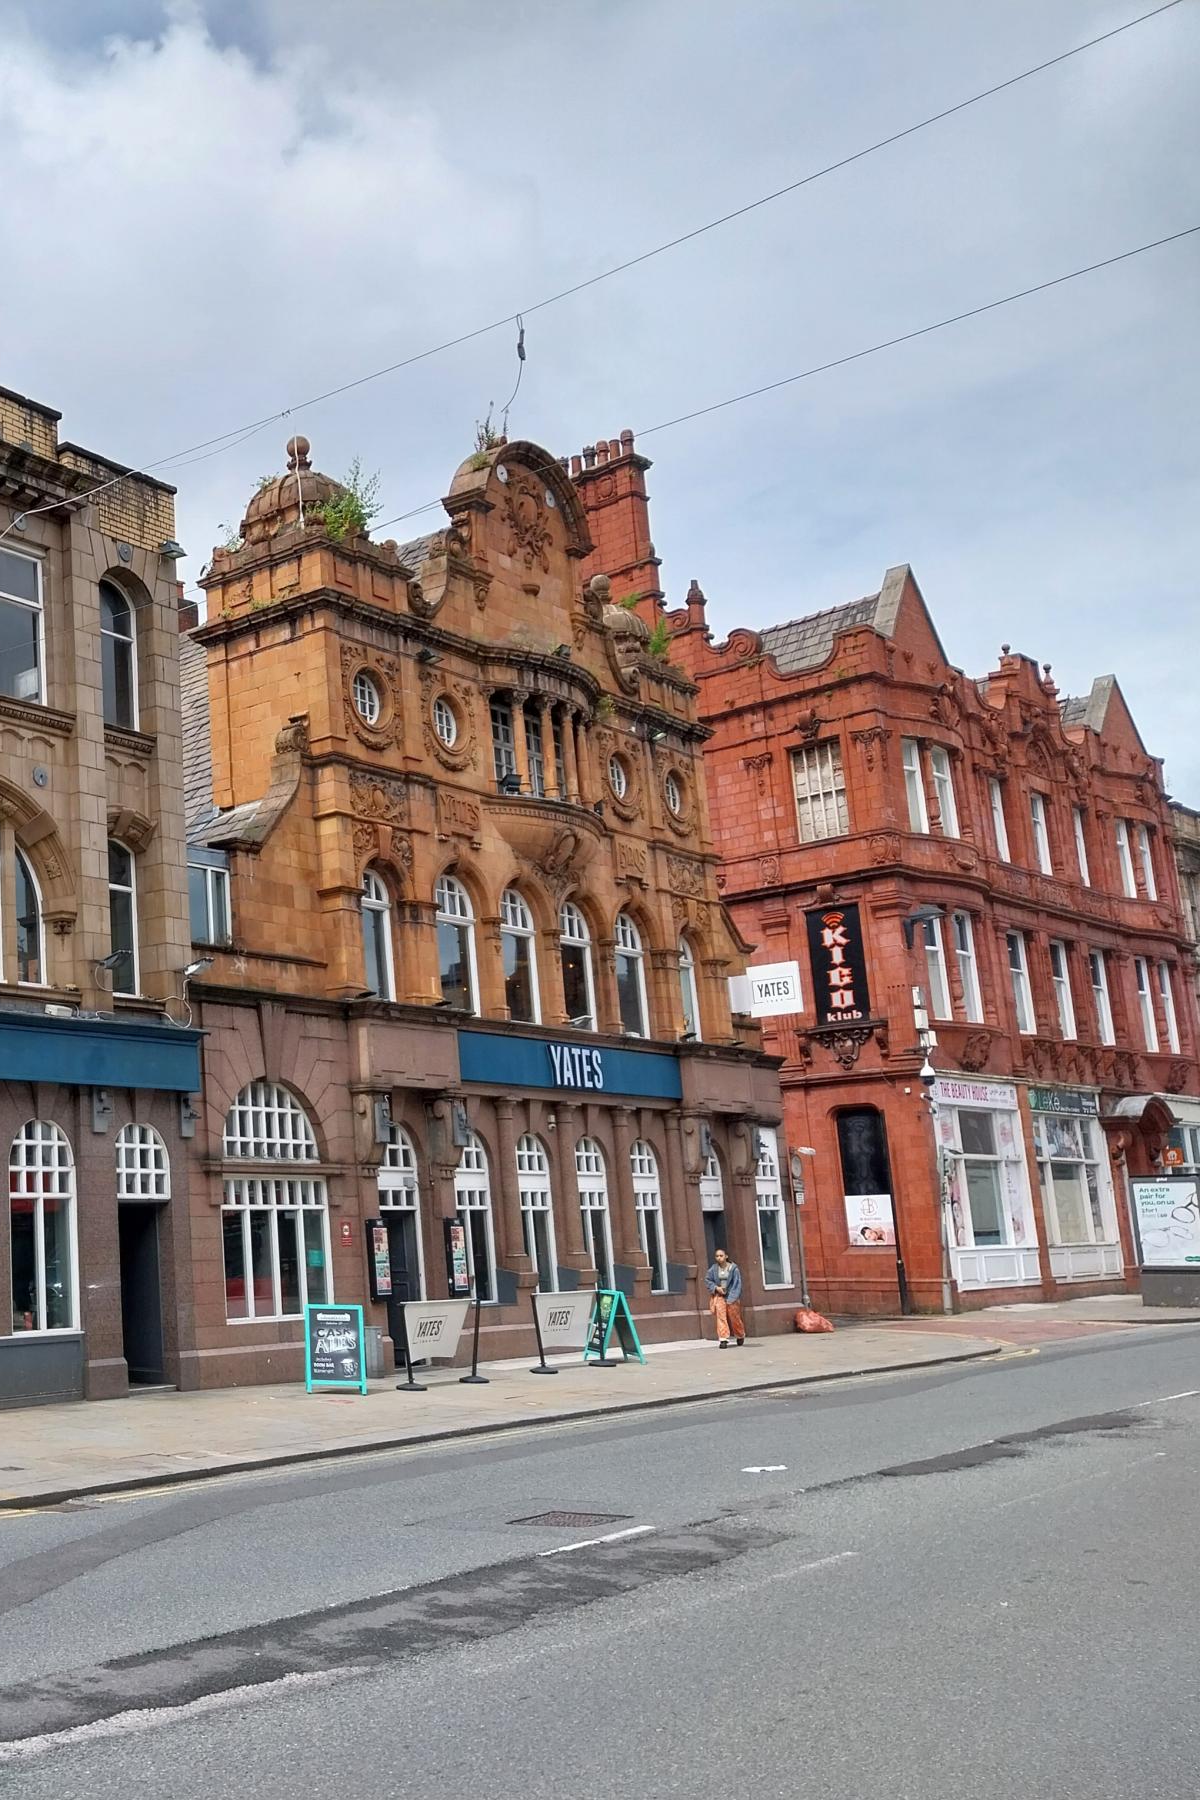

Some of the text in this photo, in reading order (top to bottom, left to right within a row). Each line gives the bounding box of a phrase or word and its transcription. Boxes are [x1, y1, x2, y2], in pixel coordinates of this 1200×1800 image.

[757, 981, 790, 998] YATES
[827, 1010, 863, 1022] klub
[550, 1045, 604, 1089] YATES
[940, 1082, 951, 1098] THE
[950, 1083, 971, 1100] BEAUTY
[971, 1085, 989, 1102] HOUSE
[548, 1310, 571, 1326] YATES
[316, 1328, 352, 1338] CASK
[417, 1320, 443, 1338] YATES
